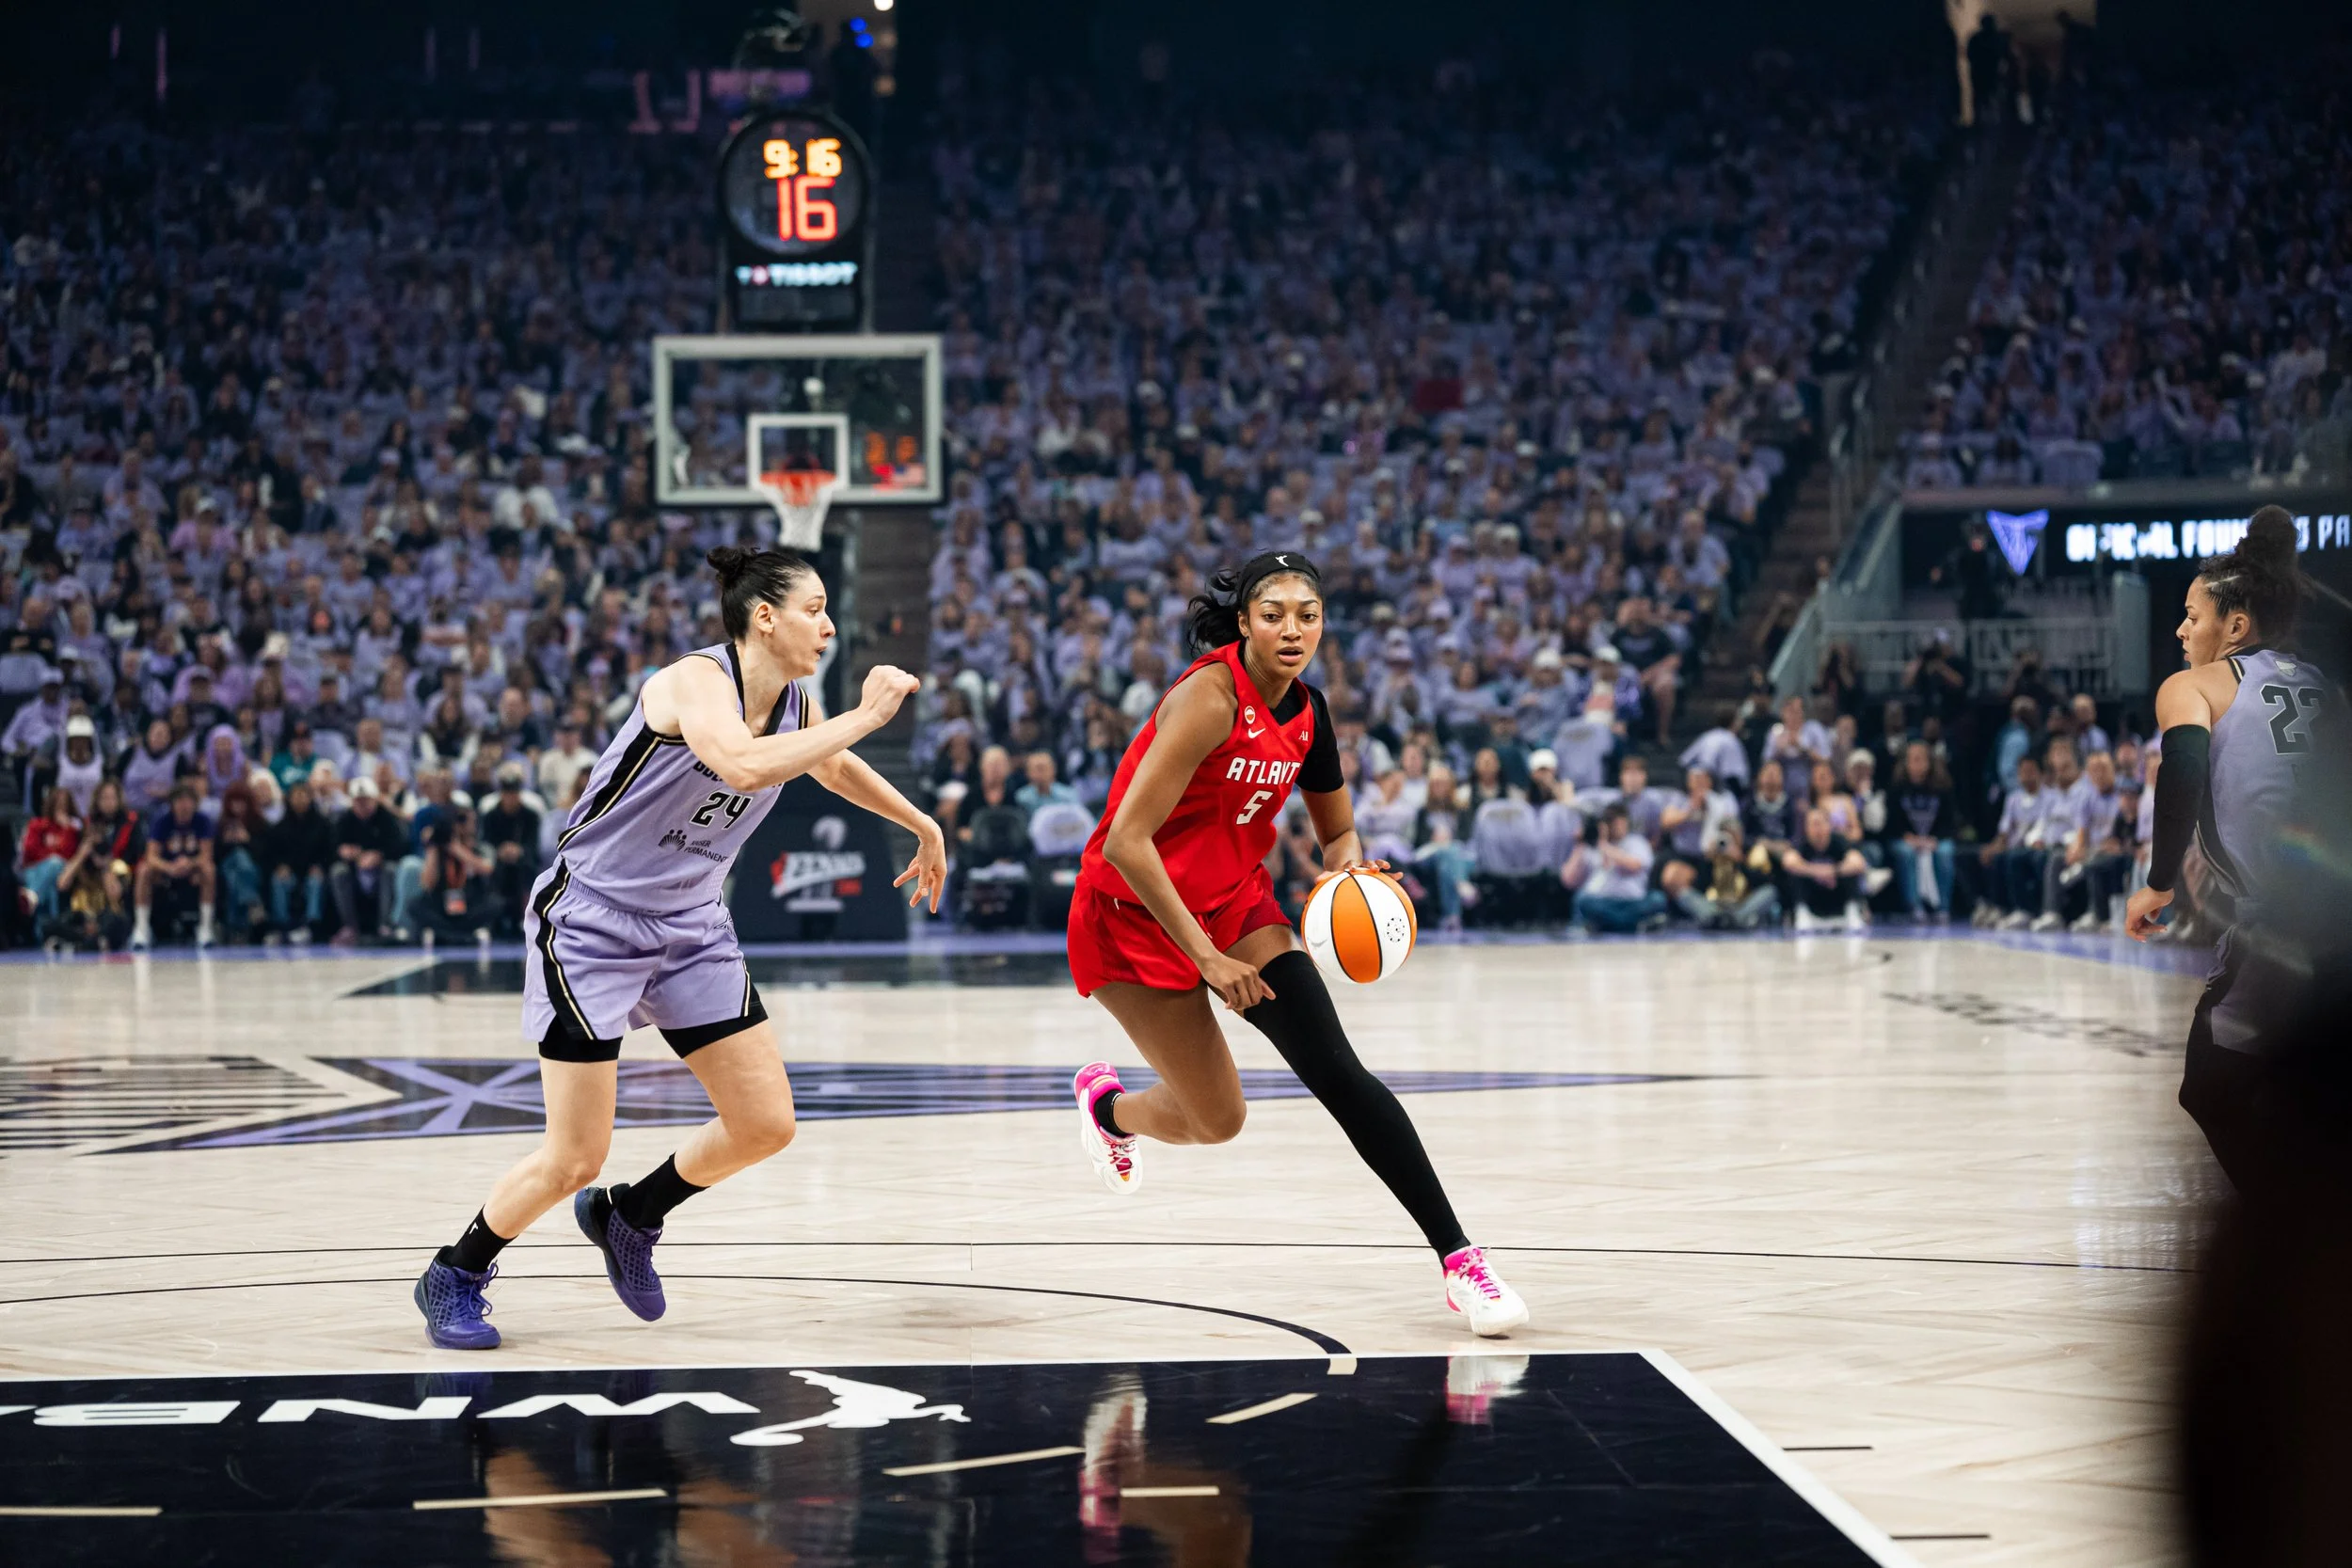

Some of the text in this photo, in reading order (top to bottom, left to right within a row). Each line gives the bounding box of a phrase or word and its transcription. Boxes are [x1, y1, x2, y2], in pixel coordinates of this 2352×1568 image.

[776, 174, 837, 242] 16
[689, 790, 754, 830] 24
[1235, 789, 1274, 825] 5
[0, 1392, 762, 1428] WNB
